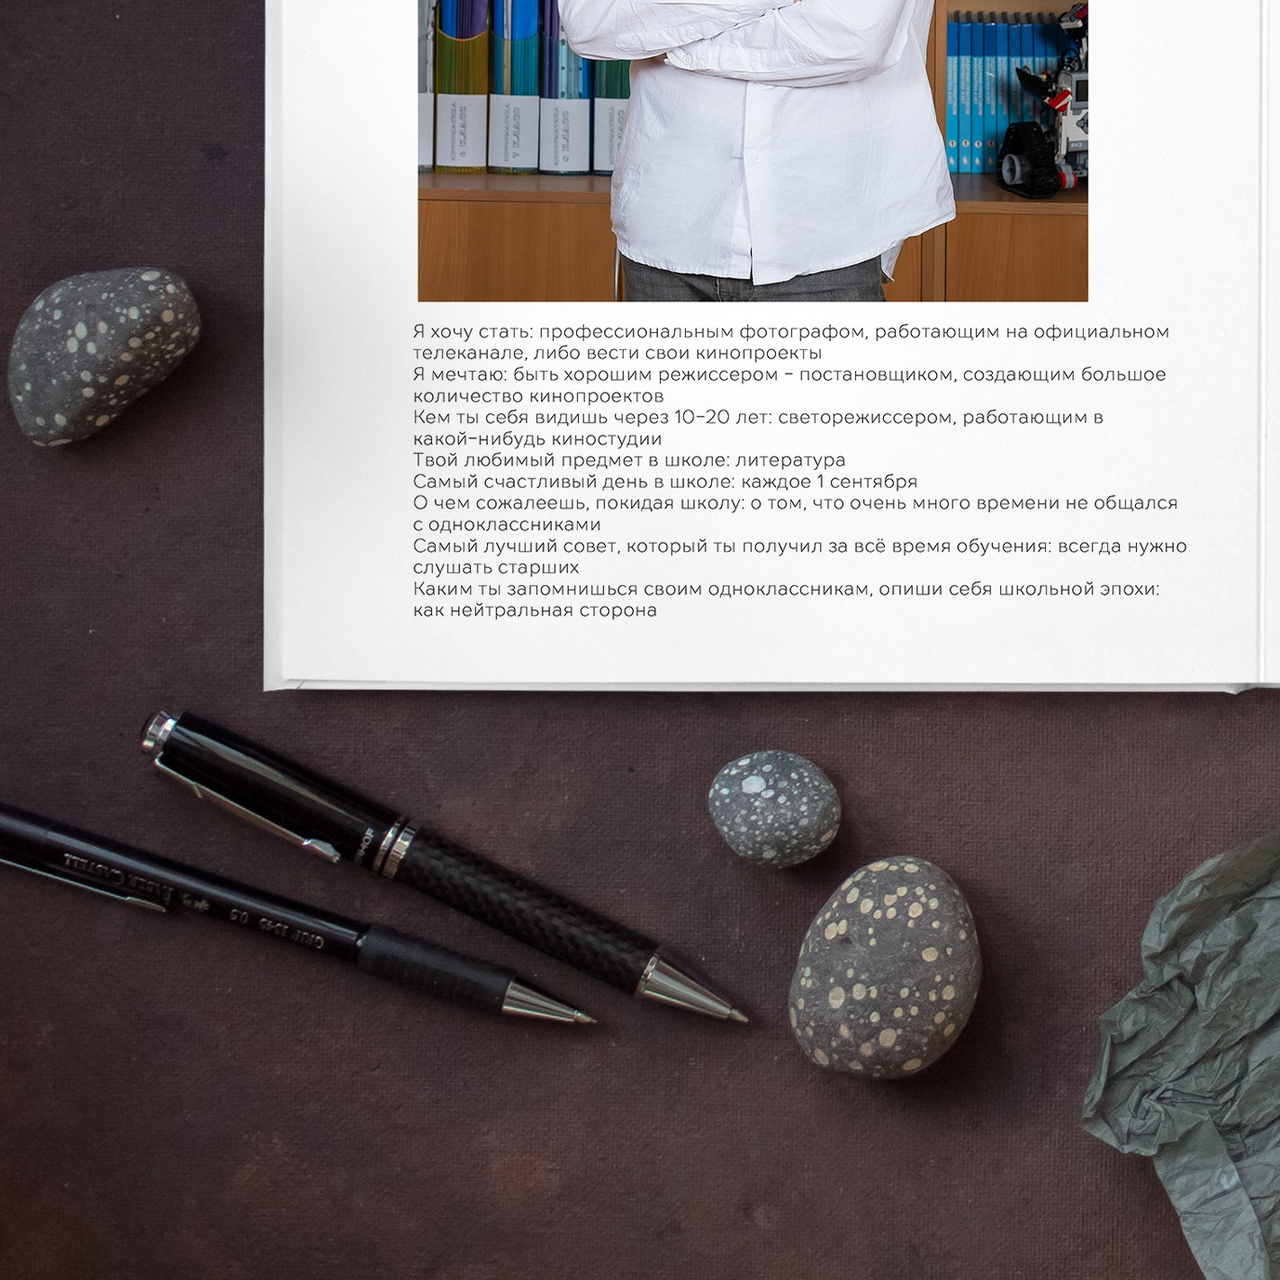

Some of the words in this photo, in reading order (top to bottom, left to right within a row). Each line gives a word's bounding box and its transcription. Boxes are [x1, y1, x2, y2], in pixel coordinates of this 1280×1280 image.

[412, 323, 425, 339] Я
[430, 326, 474, 343] хочу
[478, 326, 534, 340] стать:
[539, 323, 734, 342] профессиональным
[739, 323, 869, 342] фотографом,
[875, 322, 1000, 342] работающим
[1006, 326, 1028, 340] на
[1033, 323, 1170, 342] официальном
[412, 347, 529, 362] телеканале,
[533, 344, 581, 361] либо
[586, 347, 639, 361] вести
[645, 347, 690, 361] свои
[696, 347, 822, 364] кинопроекты
[412, 366, 425, 382] Я
[431, 369, 508, 382] мечтаю:
[513, 365, 559, 382] быть
[563, 369, 652, 385] хорошим
[658, 369, 778, 385] режиссером
[799, 369, 958, 384] постановщиком,
[963, 369, 1075, 384] создающим
[1081, 365, 1167, 382] большое
[413, 390, 524, 404] количество
[529, 390, 665, 407] кинопроектов
[413, 408, 451, 425] Кем
[455, 412, 479, 425] ты
[485, 408, 529, 425] себя
[535, 412, 608, 427] видишь
[613, 412, 670, 428] через
[674, 408, 730, 425] 10-20
[735, 412, 773, 425] лет:
[778, 412, 957, 428] светорежиссером,
[963, 408, 1088, 428] работающим
[1093, 412, 1104, 425] в
[413, 430, 546, 450] какой-нибудь
[551, 433, 662, 450] киностудии
[412, 451, 458, 468] Твой
[463, 451, 555, 468] любимый
[561, 455, 644, 471] предмет
[648, 455, 659, 468] в
[664, 455, 730, 468] школе:
[734, 455, 846, 471] литература
[412, 472, 478, 490] Самый
[483, 473, 597, 489] счастливый
[601, 476, 649, 492] день
[654, 476, 665, 489] в
[670, 476, 735, 489] школе:
[741, 476, 812, 492] каждое
[816, 473, 824, 489] 1
[829, 472, 918, 493] сентября
[412, 494, 429, 511] О
[433, 497, 470, 511] чем
[475, 497, 590, 512] сожалеешь,
[595, 497, 674, 513] покидая
[680, 497, 745, 514] школу:
[750, 497, 762, 511] о
[767, 497, 807, 512] том,
[812, 497, 845, 511] что
[849, 497, 907, 511] очень
[912, 497, 971, 511] много
[976, 497, 1060, 514] времени
[1065, 497, 1089, 511] не
[1093, 494, 1178, 513] общался
[412, 519, 424, 532] с
[428, 519, 601, 535] одноклассниками
[412, 537, 478, 554] Самый
[482, 537, 558, 557] лучший
[563, 541, 621, 555] совет,
[626, 537, 708, 557] который
[712, 541, 736, 554] ты
[742, 541, 823, 558] получил
[828, 541, 848, 554] за
[854, 537, 886, 554] всё
[892, 541, 951, 557] время
[956, 537, 1052, 558] обучения:
[1058, 541, 1122, 556] всегда
[1127, 541, 1188, 557] нужно
[412, 562, 493, 579] слушать
[497, 562, 580, 578] старших
[413, 580, 473, 597] Каким
[477, 584, 501, 597] ты
[506, 584, 638, 597] запомнишься
[643, 584, 702, 597] своим
[708, 584, 874, 599] одноклассникам,
[878, 584, 943, 597] опиши
[948, 580, 992, 597] себя
[999, 580, 1094, 597] школьной
[1099, 584, 1160, 597] эпохи:
[413, 605, 445, 618] как
[450, 601, 574, 621] нейтральная
[579, 605, 658, 621] сторона
